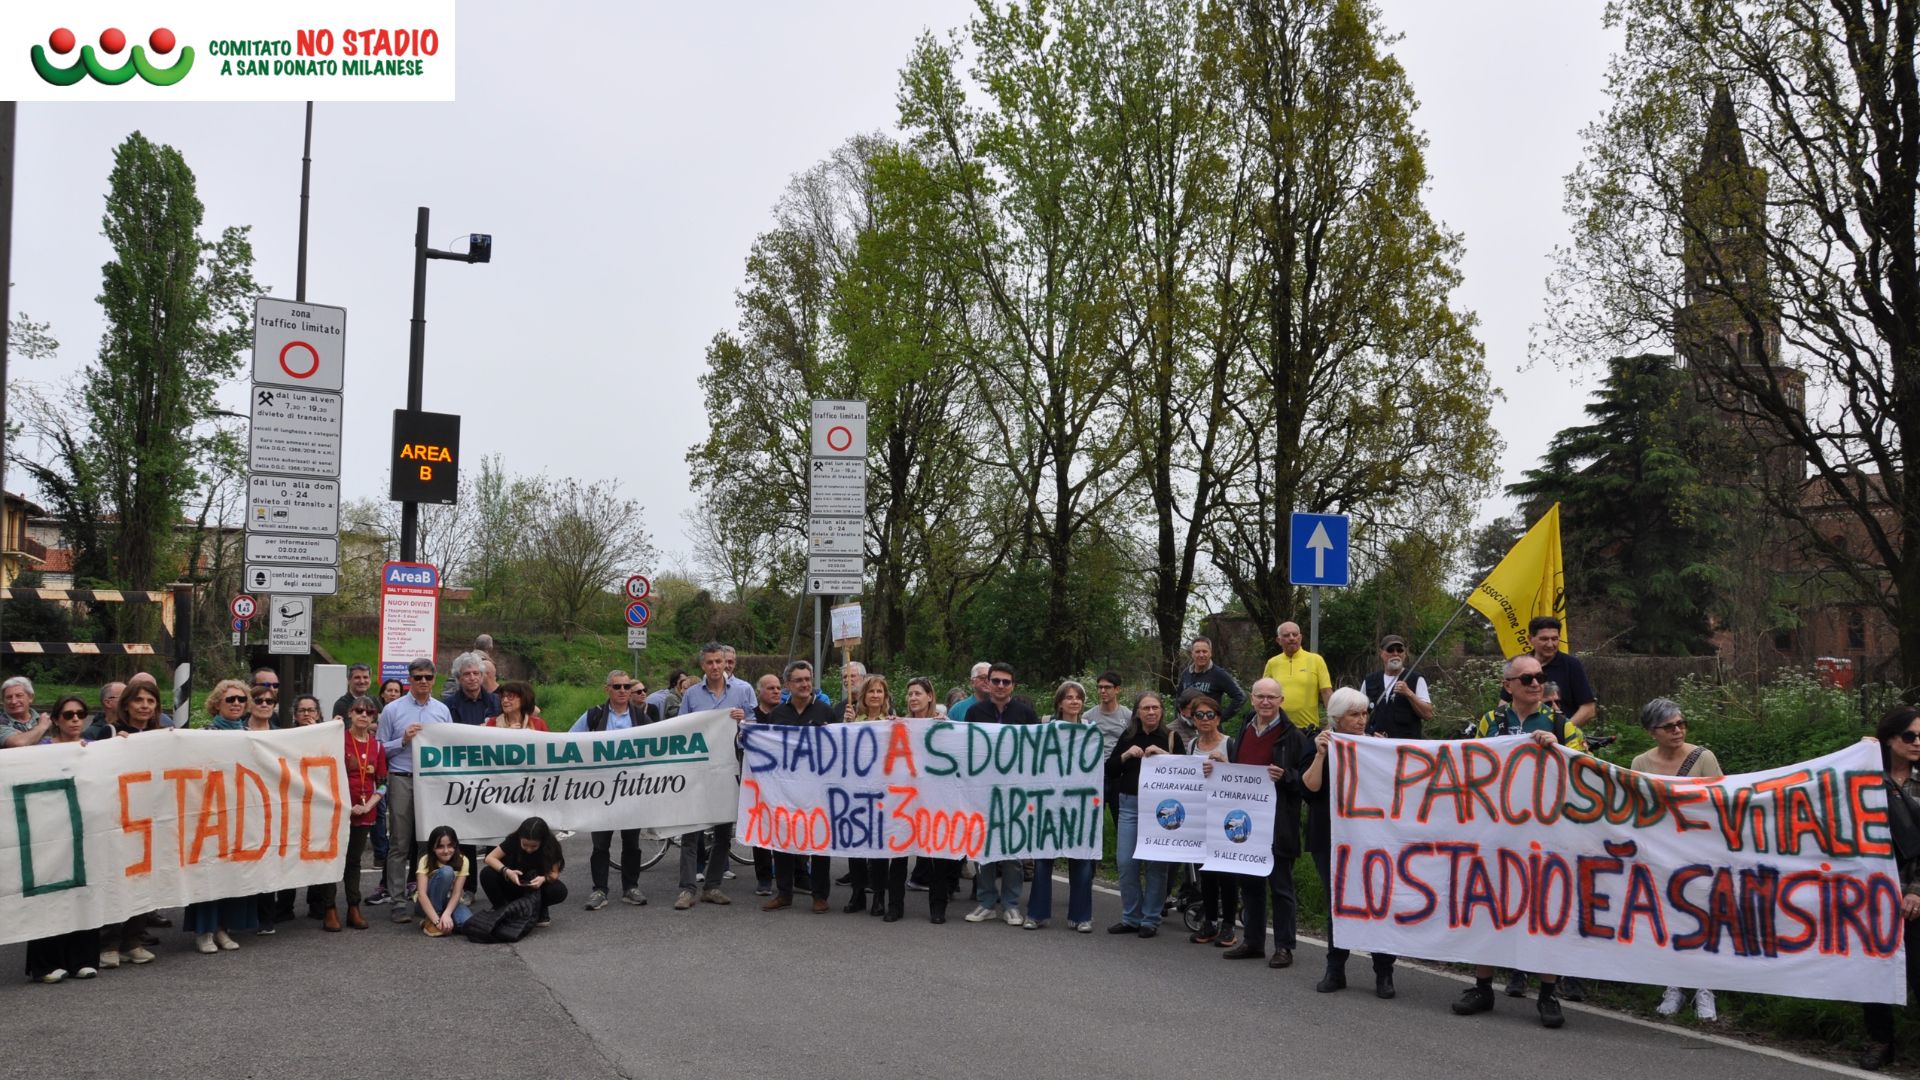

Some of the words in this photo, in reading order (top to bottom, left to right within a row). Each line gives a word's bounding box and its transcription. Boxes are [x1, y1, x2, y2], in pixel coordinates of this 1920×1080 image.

[292, 310, 310, 318] zona
[261, 317, 296, 329] traffico
[302, 322, 340, 335] limitato
[298, 414, 327, 422] transito
[400, 444, 452, 462] AREA
[420, 466, 432, 480] B
[294, 500, 325, 508] transito
[390, 570, 431, 583] AreaB
[420, 743, 536, 768] DIFENDI
[546, 742, 584, 764] LA
[593, 732, 708, 762] NATURA
[742, 724, 878, 777] STADIO
[884, 722, 918, 777] A
[1151, 782, 1204, 791] CHIARAVALLE
[1235, 776, 1262, 784] STADIO
[1336, 740, 1384, 819] IL
[1390, 742, 1567, 825] PARCO
[443, 776, 536, 813] Difendi
[542, 774, 560, 802] il
[565, 776, 604, 800] tuo
[604, 770, 686, 807] futuro
[1220, 791, 1269, 802] CHIARAVALLE
[118, 756, 342, 878] STADIO
[1222, 852, 1237, 860] ALLE
[1239, 854, 1267, 864] CICOGNE
[1334, 844, 1394, 920] LO
